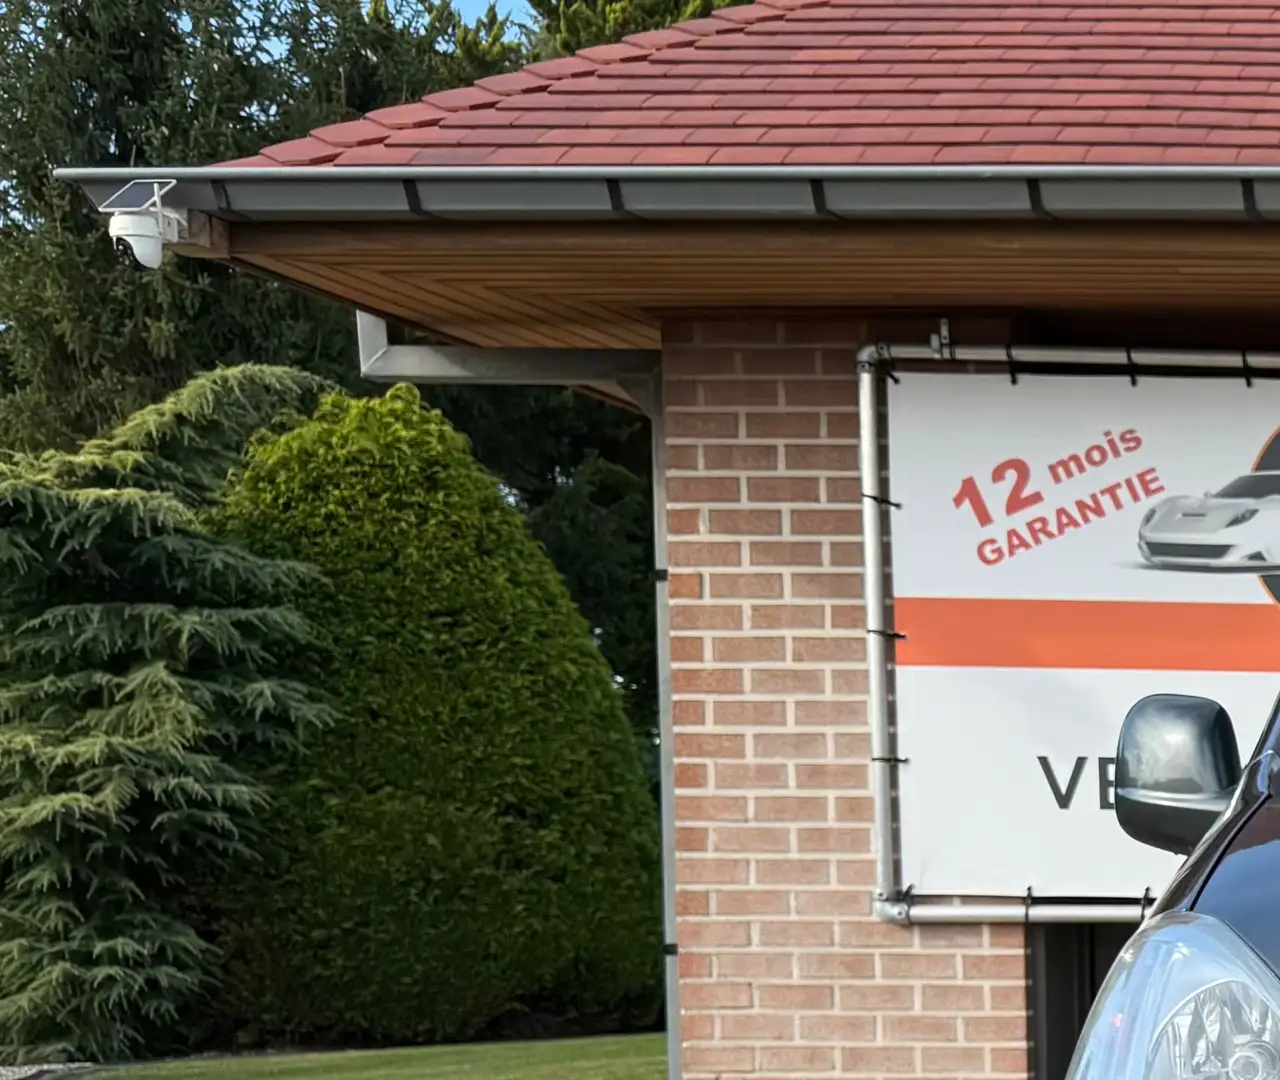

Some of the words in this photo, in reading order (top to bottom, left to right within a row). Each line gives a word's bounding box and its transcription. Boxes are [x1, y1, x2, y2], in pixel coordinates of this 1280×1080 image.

[952, 458, 1045, 528] 12
[1048, 428, 1143, 485] mois
[976, 467, 1166, 567] GARANTIE
